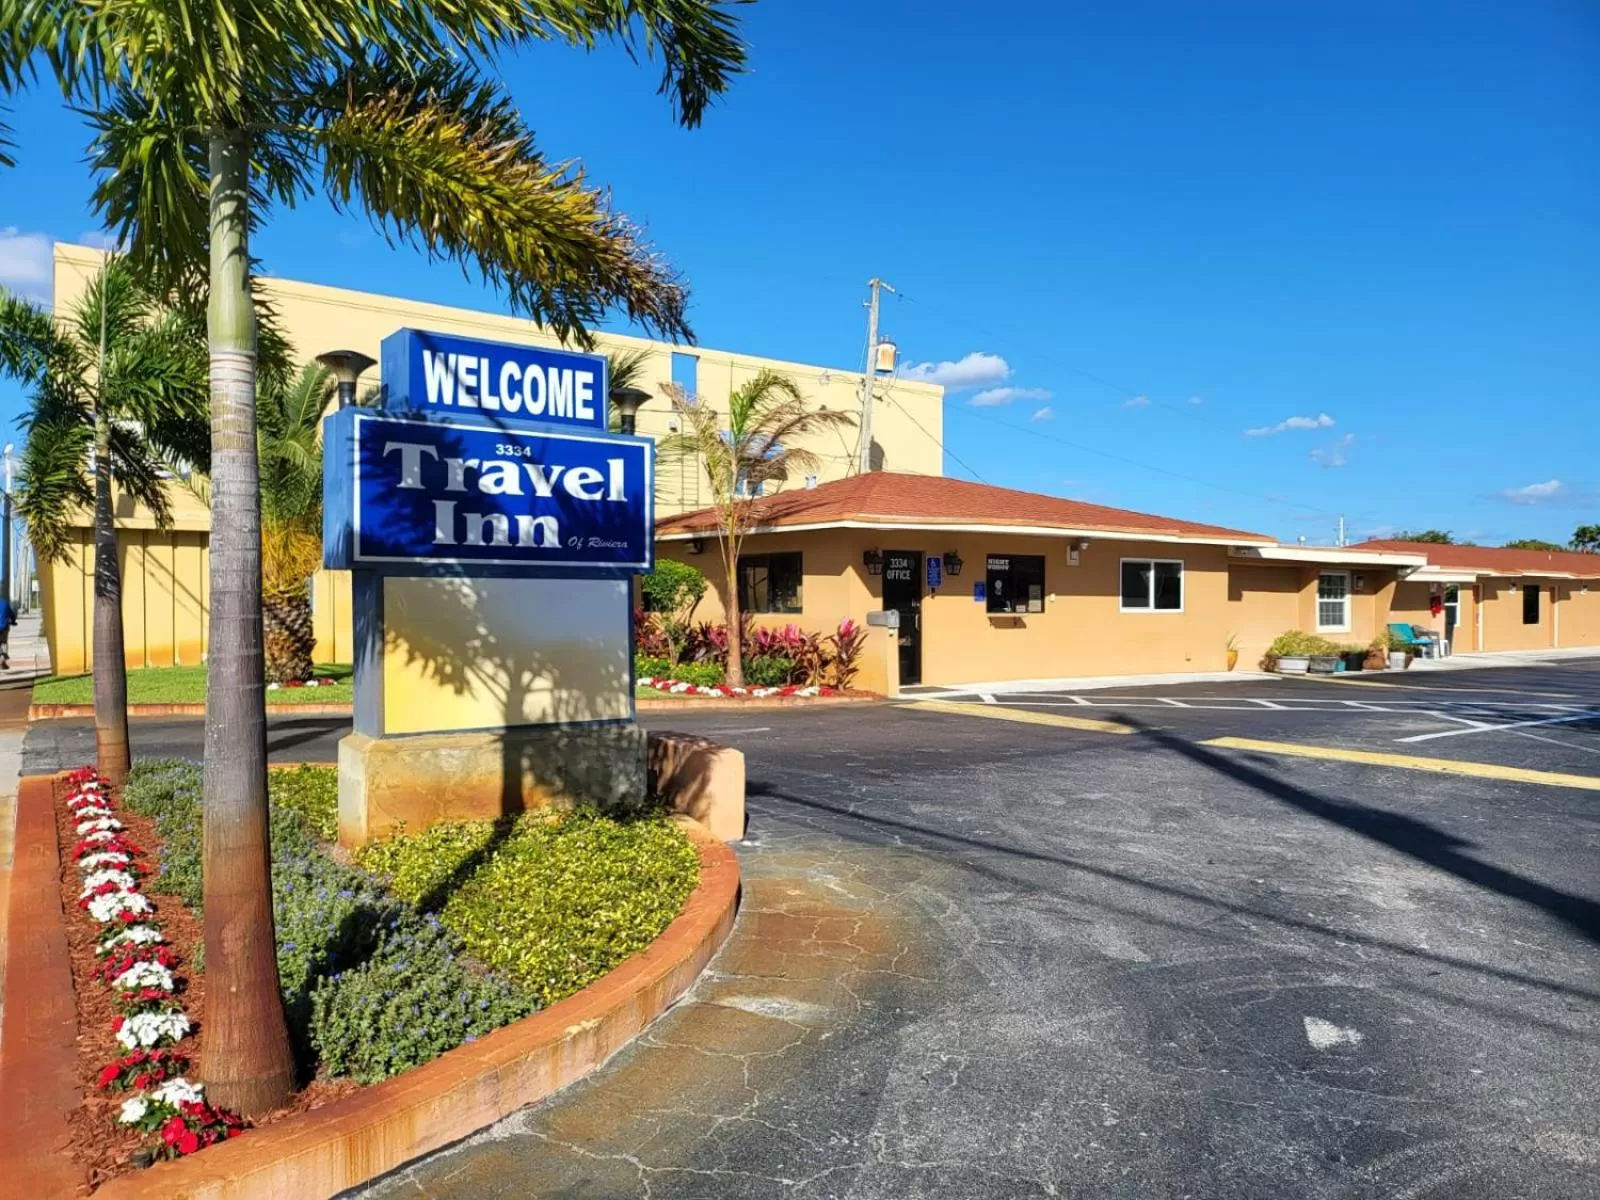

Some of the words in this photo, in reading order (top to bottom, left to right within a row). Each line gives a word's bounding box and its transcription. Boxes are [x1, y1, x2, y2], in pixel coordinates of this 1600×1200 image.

[422, 350, 595, 420] WELCOME
[495, 443, 532, 457] 3334
[383, 441, 628, 502] Travel
[432, 500, 562, 549] Inn
[567, 536, 583, 551] Of
[890, 559, 908, 569] 3334
[886, 570, 911, 580] OFFICE
